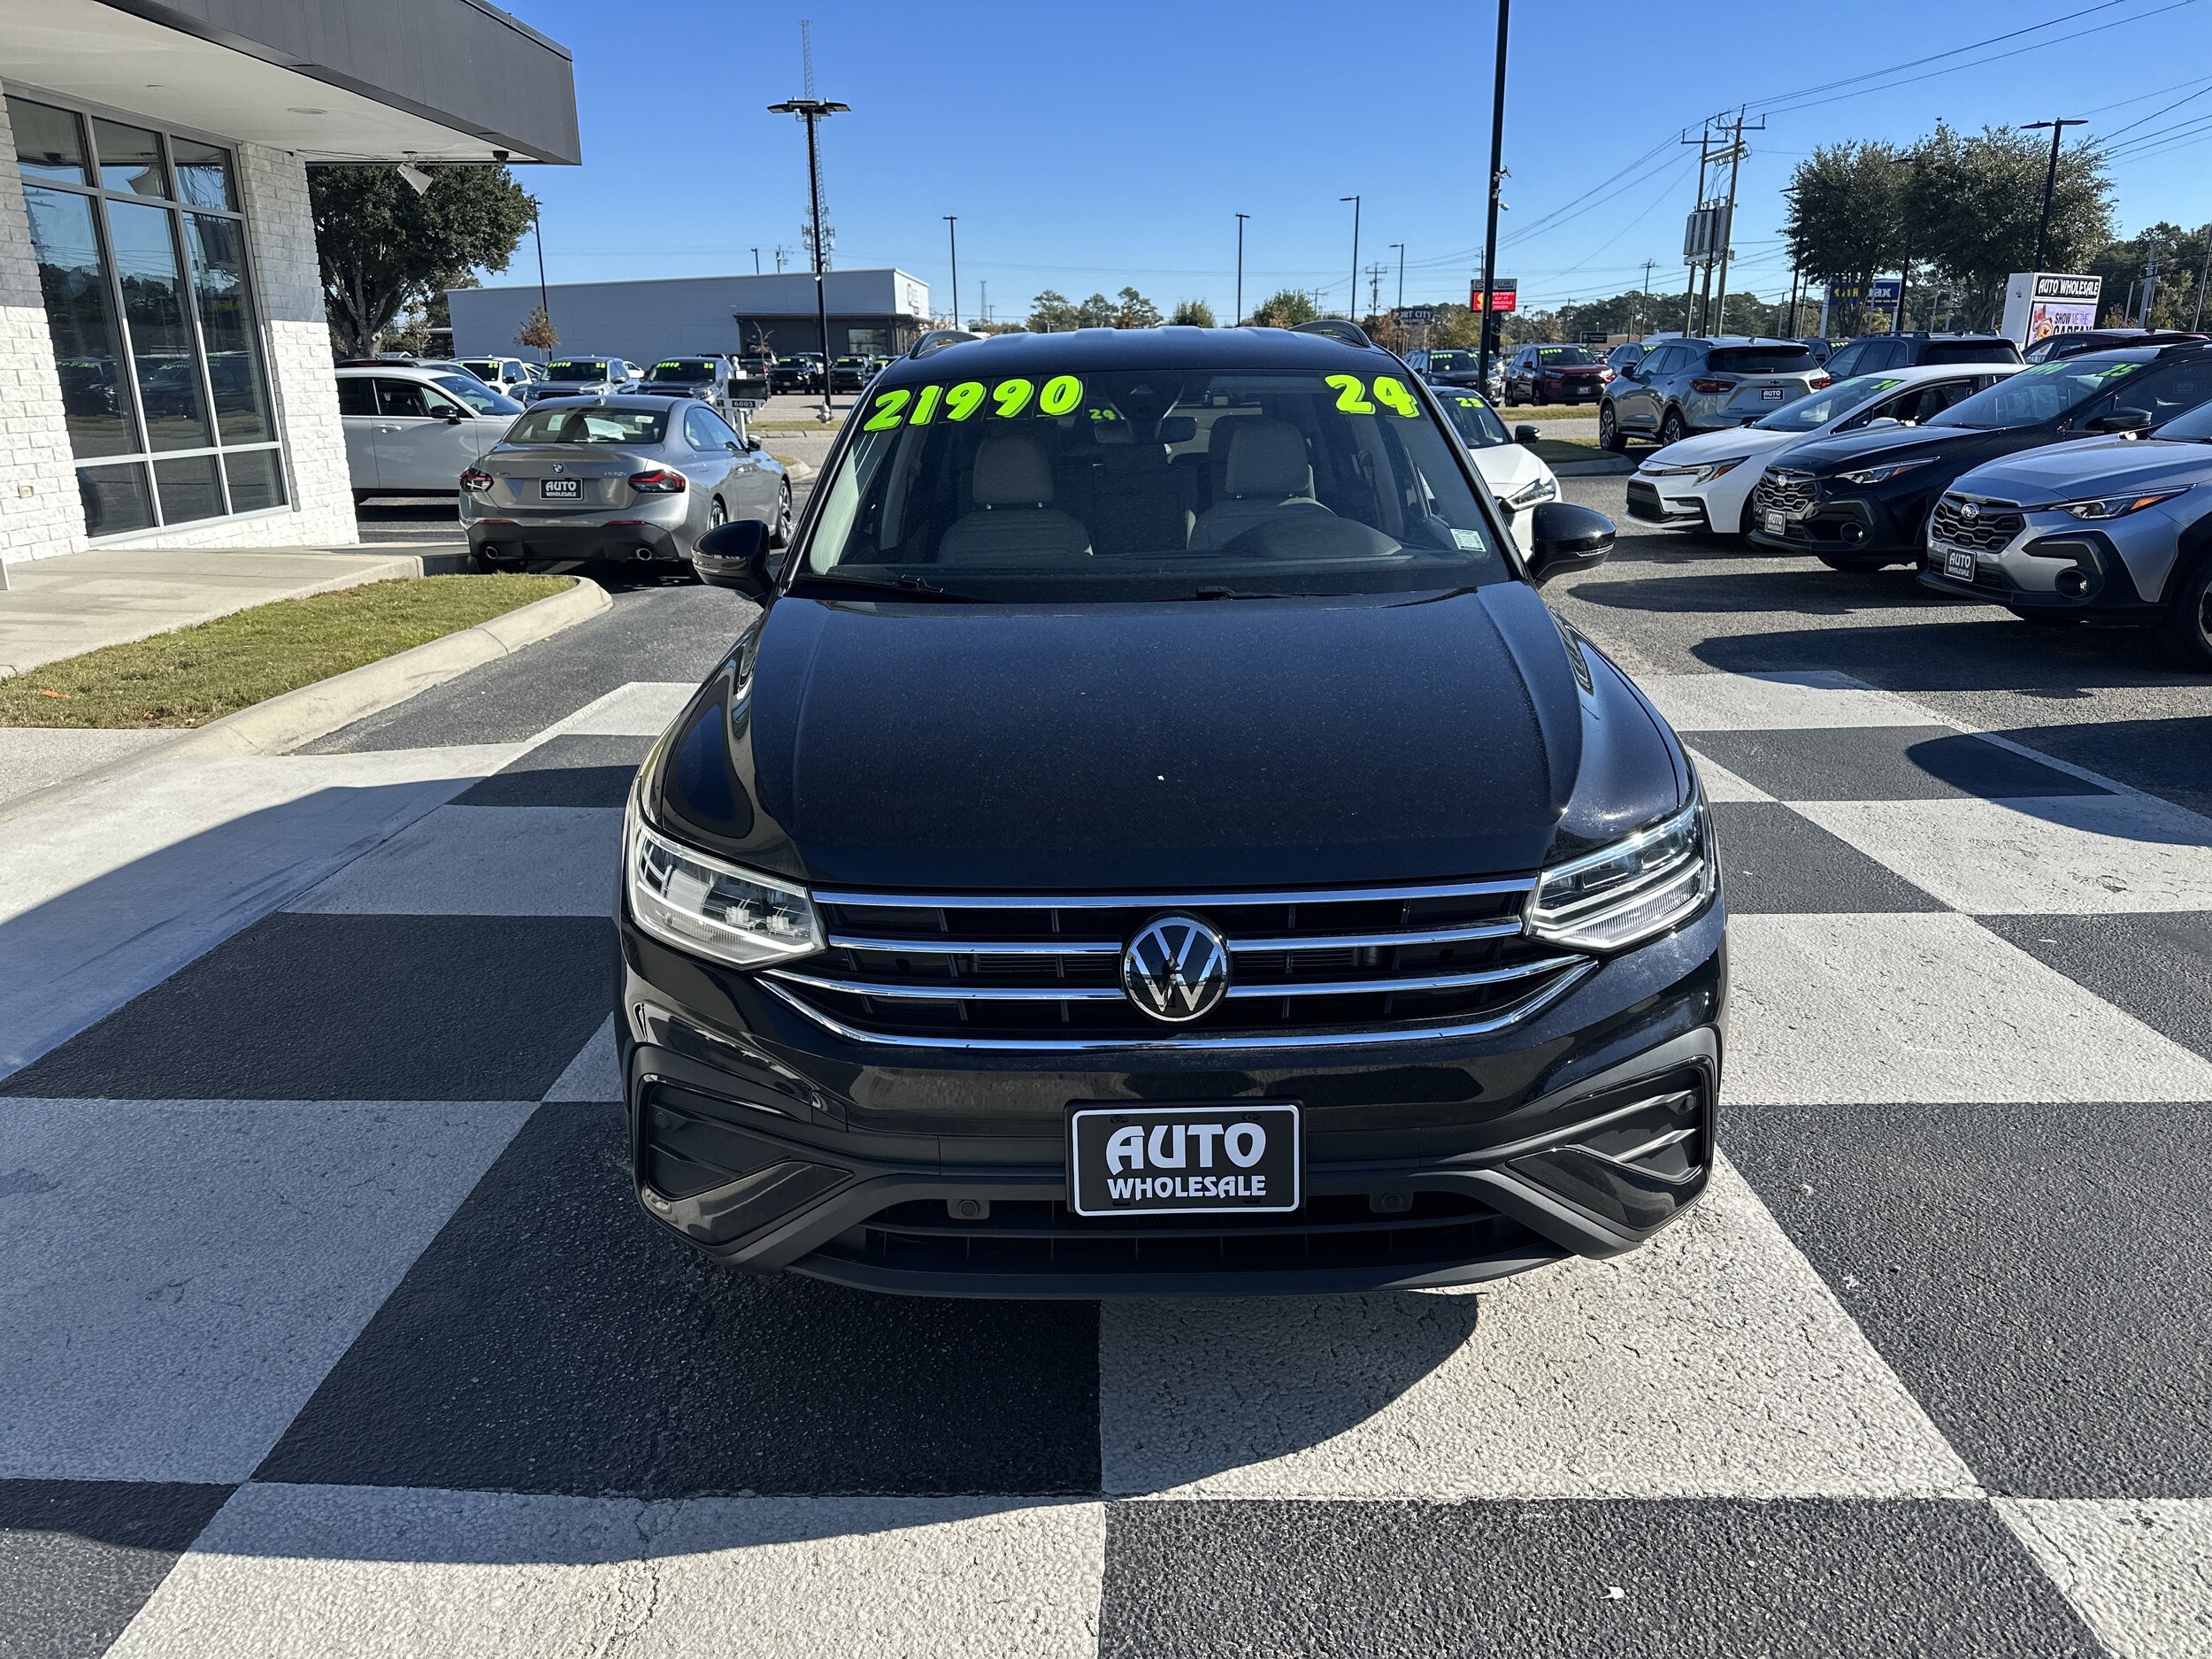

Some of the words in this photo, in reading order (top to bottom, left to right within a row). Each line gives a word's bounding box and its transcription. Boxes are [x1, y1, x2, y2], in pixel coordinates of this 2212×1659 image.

[2038, 278, 2059, 295] AUTO
[2060, 280, 2099, 296] WHOLESALE
[1415, 310, 1432, 319] CITY
[2054, 312, 2071, 325] SHOW
[2097, 364, 2142, 377] 25
[864, 375, 1084, 432] 21990
[1325, 374, 1420, 419] 24
[1455, 397, 1485, 408] 23
[1088, 408, 1117, 420] 24
[545, 480, 577, 492] AUTO
[1768, 512, 1783, 526] AUTO
[1949, 552, 1971, 569] AUTO
[1948, 565, 1970, 577] WHOLESALE
[1105, 1122, 1267, 1176] AUTO
[1106, 1175, 1267, 1202] WHOLESALE
